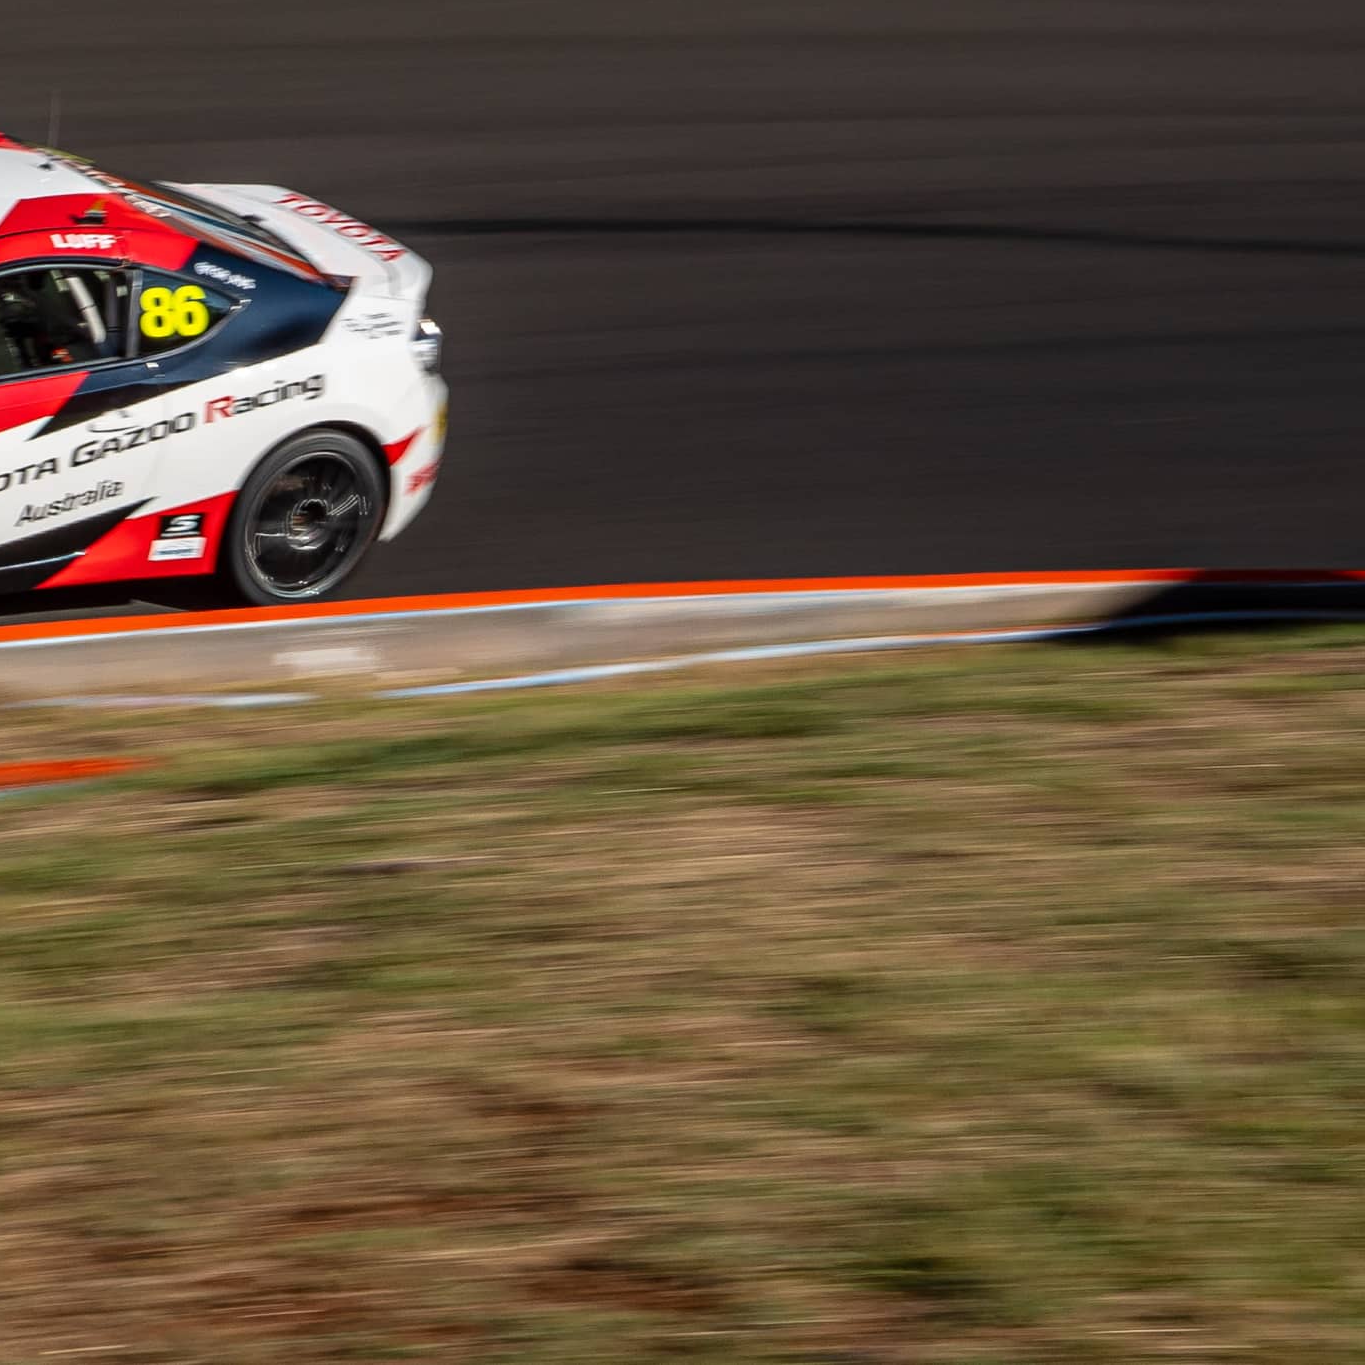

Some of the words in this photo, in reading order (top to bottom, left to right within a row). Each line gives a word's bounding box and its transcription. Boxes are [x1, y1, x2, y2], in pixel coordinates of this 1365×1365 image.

[139, 285, 210, 338] 86
[69, 412, 196, 468] GAZOO
[204, 373, 326, 425] Racing
[15, 479, 124, 527] Australia
